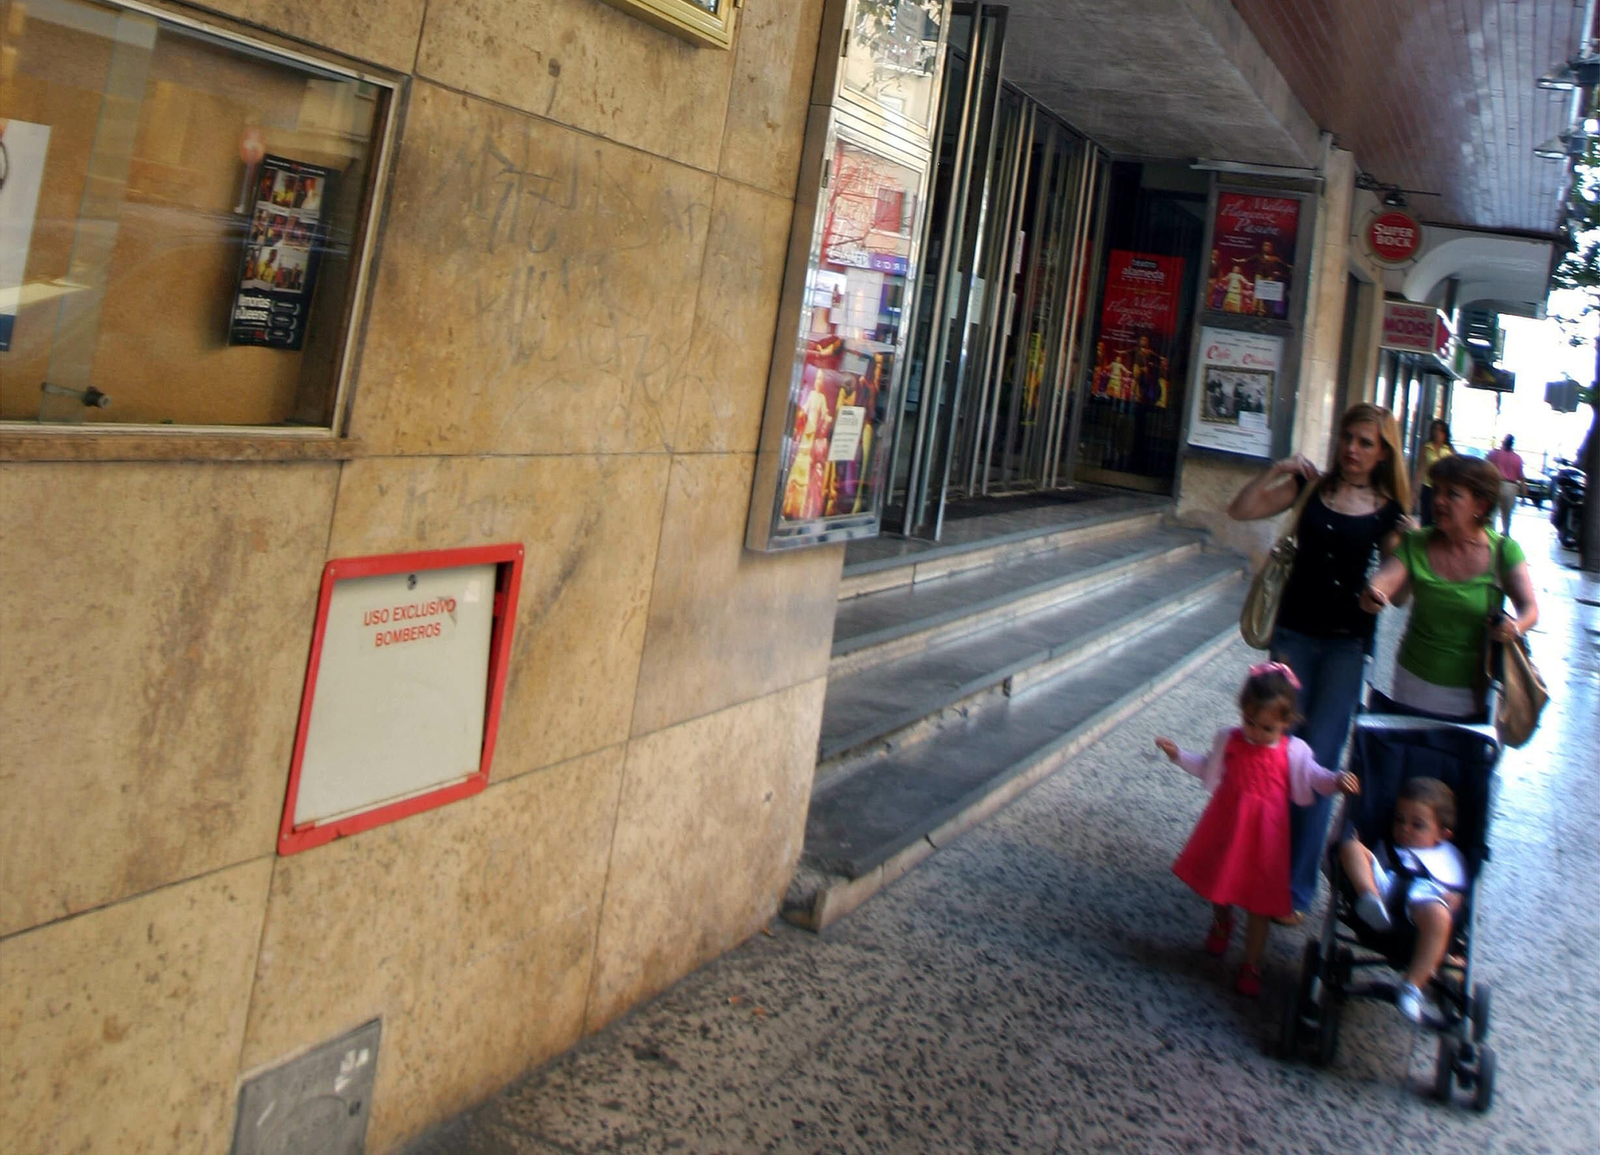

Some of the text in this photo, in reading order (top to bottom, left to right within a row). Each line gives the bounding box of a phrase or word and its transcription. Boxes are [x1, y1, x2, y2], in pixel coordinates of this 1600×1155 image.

[1373, 223, 1414, 238] SUPER
[1376, 235, 1412, 248] BOCK
[1121, 266, 1165, 280] alameda
[1383, 316, 1434, 338] MODAS
[364, 598, 457, 626] USO EXCLUSIVO
[375, 622, 441, 647] BOMBEROS
